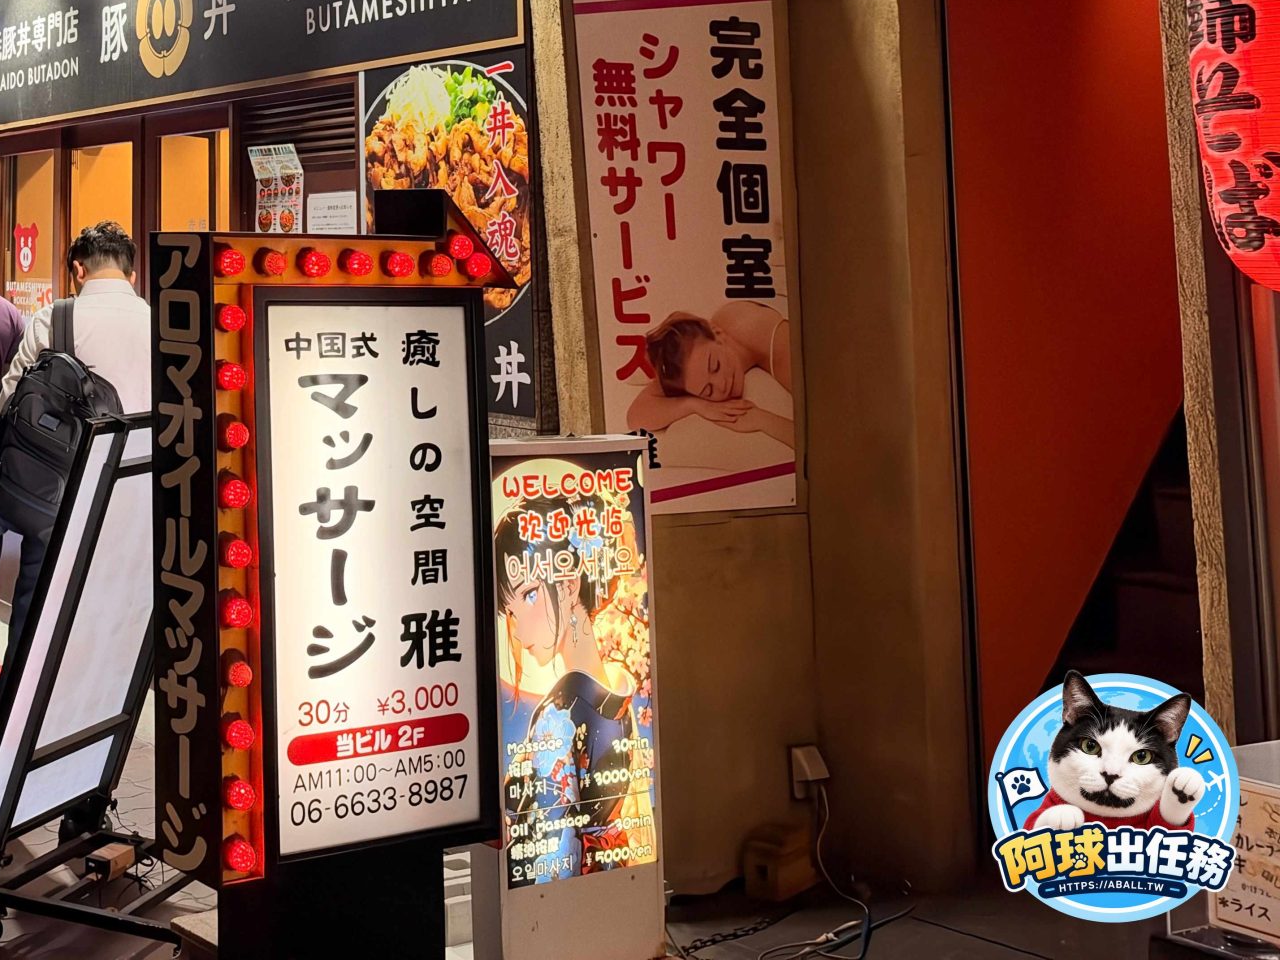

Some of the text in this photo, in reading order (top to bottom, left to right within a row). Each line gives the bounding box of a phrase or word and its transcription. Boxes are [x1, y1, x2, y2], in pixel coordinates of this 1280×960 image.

[100, 2, 129, 64] 豚
[27, 56, 79, 85] BUTADON
[639, 33, 687, 241] シャワー
[484, 60, 521, 261] 一丼入魂
[709, 16, 776, 299] 完全個室
[592, 58, 656, 383] 無料サービス
[284, 331, 379, 360] 中国式
[400, 330, 462, 670] 癒しの空間 雅
[502, 468, 634, 499] WELCOME
[297, 373, 377, 680] マッサージ
[518, 506, 625, 542] 欢迎光临
[157, 233, 208, 871] アロマオイルマッサージ
[298, 682, 459, 727] 30分 ¥3,000
[336, 724, 425, 758] 当ビル 2F
[507, 737, 649, 756] Massage 30min
[509, 778, 548, 800] 마사지
[594, 767, 651, 786] 3000yen
[290, 774, 468, 827] 06-6633-8987
[510, 813, 652, 838] Oil Massage 30min
[511, 855, 574, 882] 오일마사지
[595, 845, 652, 864] 5000yen
